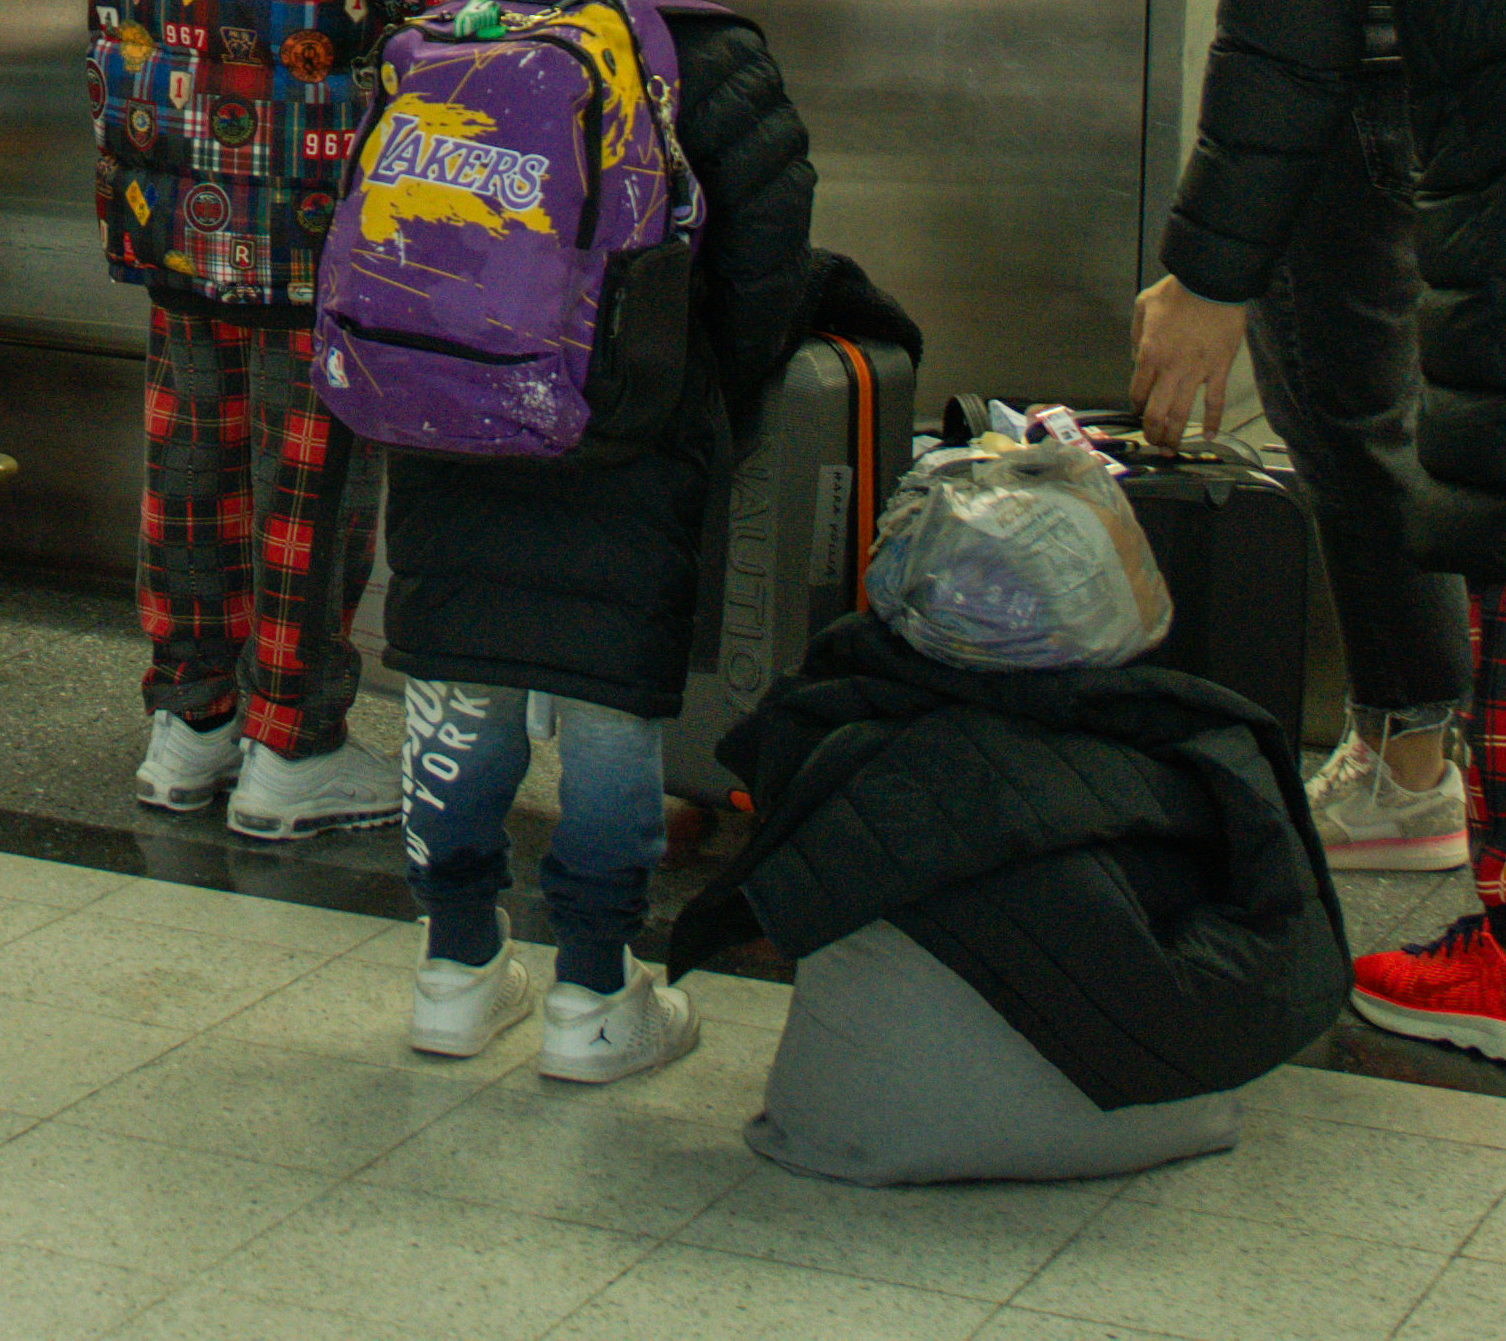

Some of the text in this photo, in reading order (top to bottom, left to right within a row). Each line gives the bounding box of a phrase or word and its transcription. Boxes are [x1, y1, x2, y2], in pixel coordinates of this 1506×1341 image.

[166, 25, 205, 48] 967
[366, 112, 550, 212] LAKERS
[236, 245, 249, 263] R
[724, 432, 772, 714] NAUTIC
[415, 687, 490, 811] YORK
